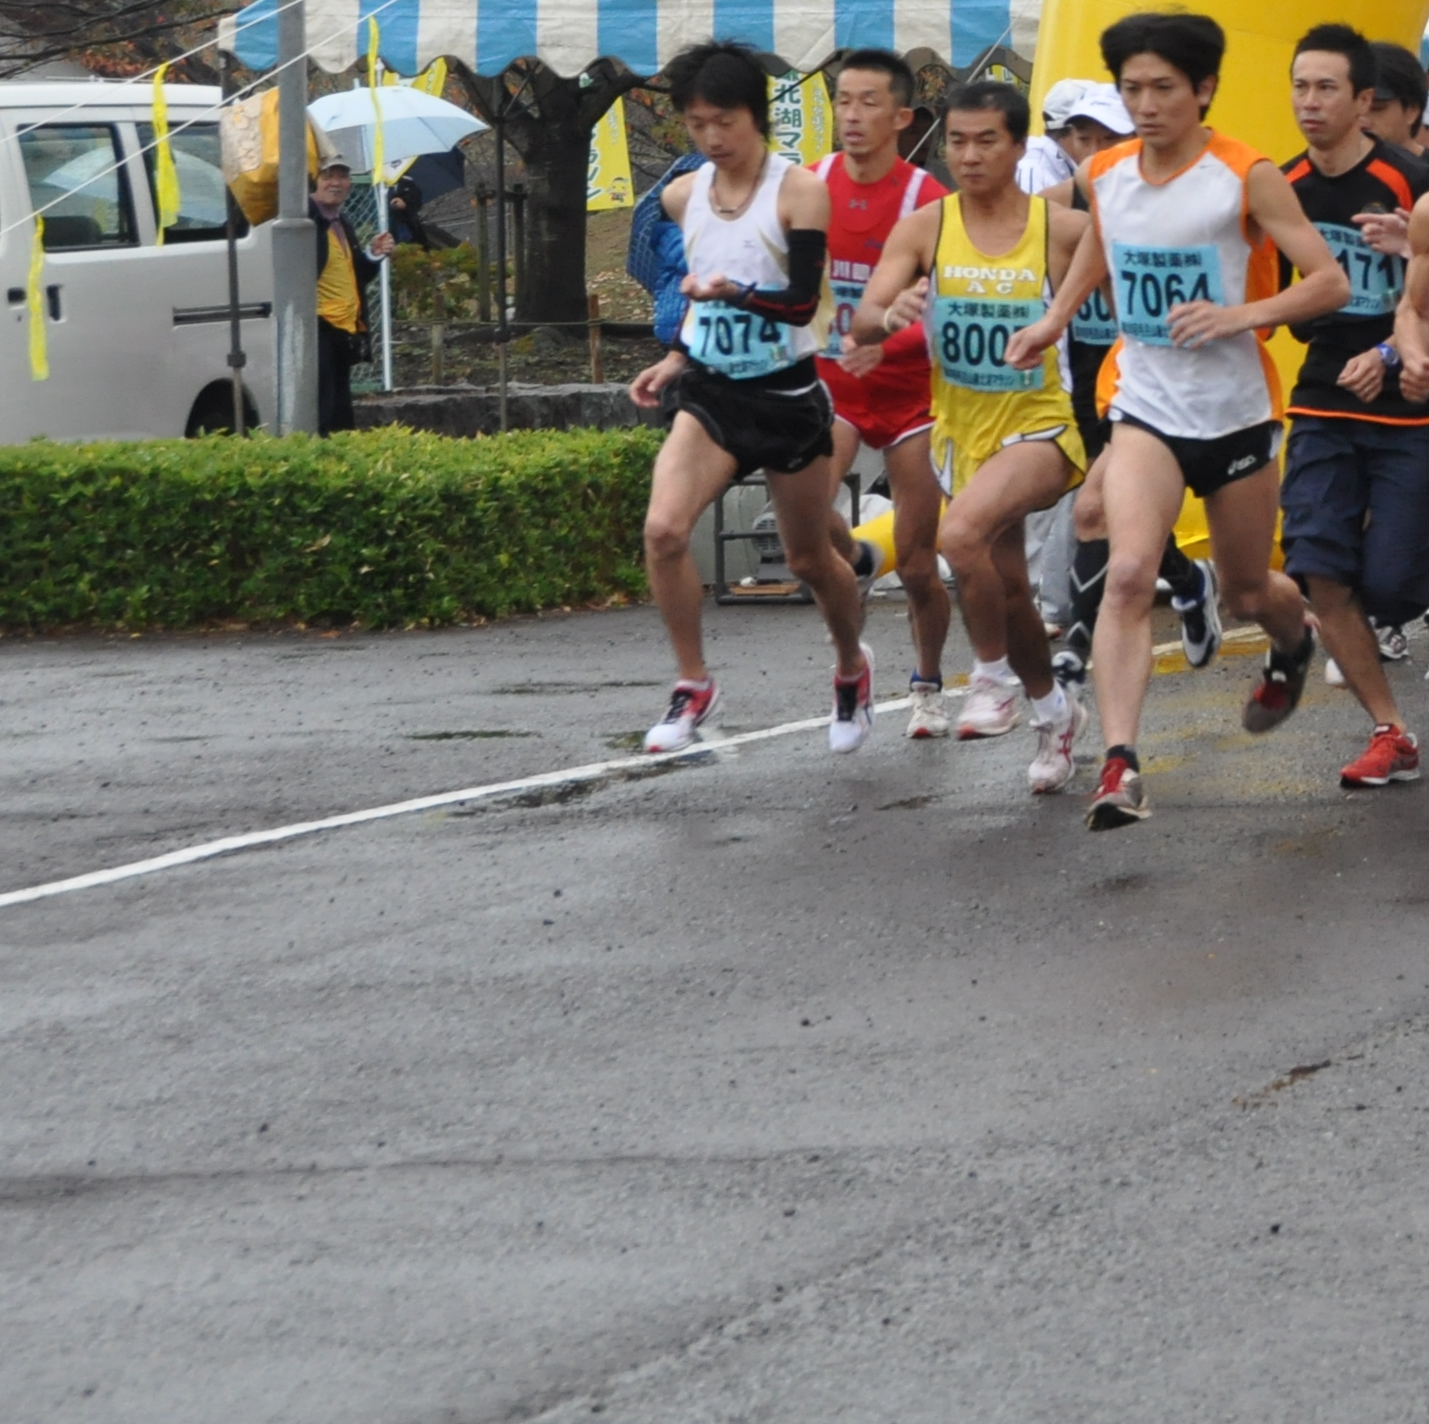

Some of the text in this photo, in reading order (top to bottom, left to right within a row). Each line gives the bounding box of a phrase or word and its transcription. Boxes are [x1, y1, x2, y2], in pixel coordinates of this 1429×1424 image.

[773, 75, 803, 166] 北湖マラ
[943, 264, 1038, 282] HONDA
[1334, 248, 1396, 290] 171
[1120, 270, 1215, 318] 7064
[699, 313, 783, 358] 7074
[942, 321, 1025, 368] 800
